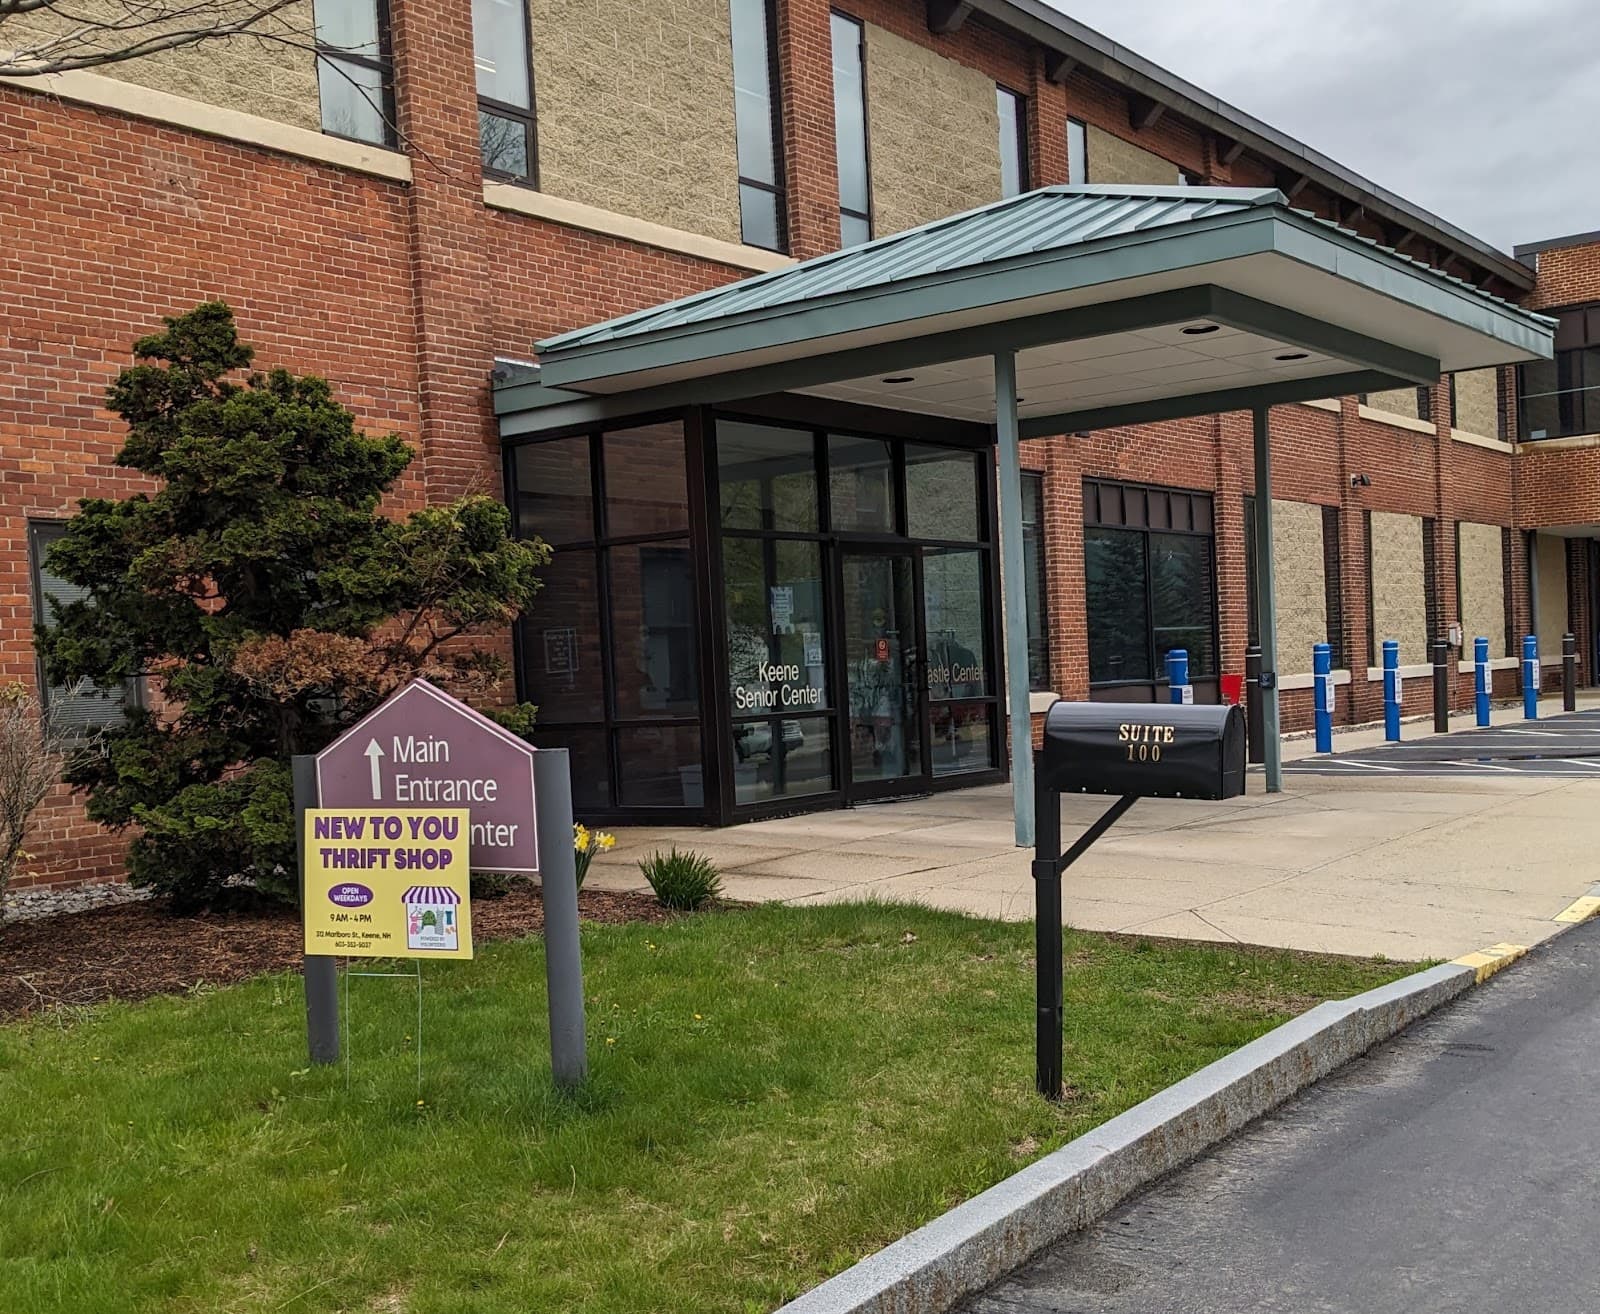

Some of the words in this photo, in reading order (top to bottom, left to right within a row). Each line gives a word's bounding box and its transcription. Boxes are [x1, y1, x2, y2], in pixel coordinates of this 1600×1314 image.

[758, 661, 799, 683] Keene
[928, 663, 950, 683] astle
[736, 685, 778, 709] Senior
[781, 683, 823, 706] Center
[1119, 723, 1175, 743] SUITE
[393, 735, 449, 763] Main
[1127, 743, 1161, 762] 100
[395, 774, 498, 802] Entrance
[314, 816, 365, 840] NEW
[369, 816, 403, 840] TO
[407, 816, 459, 840] YOU
[471, 820, 518, 847] nter
[319, 848, 391, 869] THRIFT
[394, 848, 453, 870] SHOP
[333, 894, 369, 903] WEEKDAYS
[341, 887, 359, 895] OPEN
[335, 914, 349, 922] AM
[359, 914, 372, 923] PM
